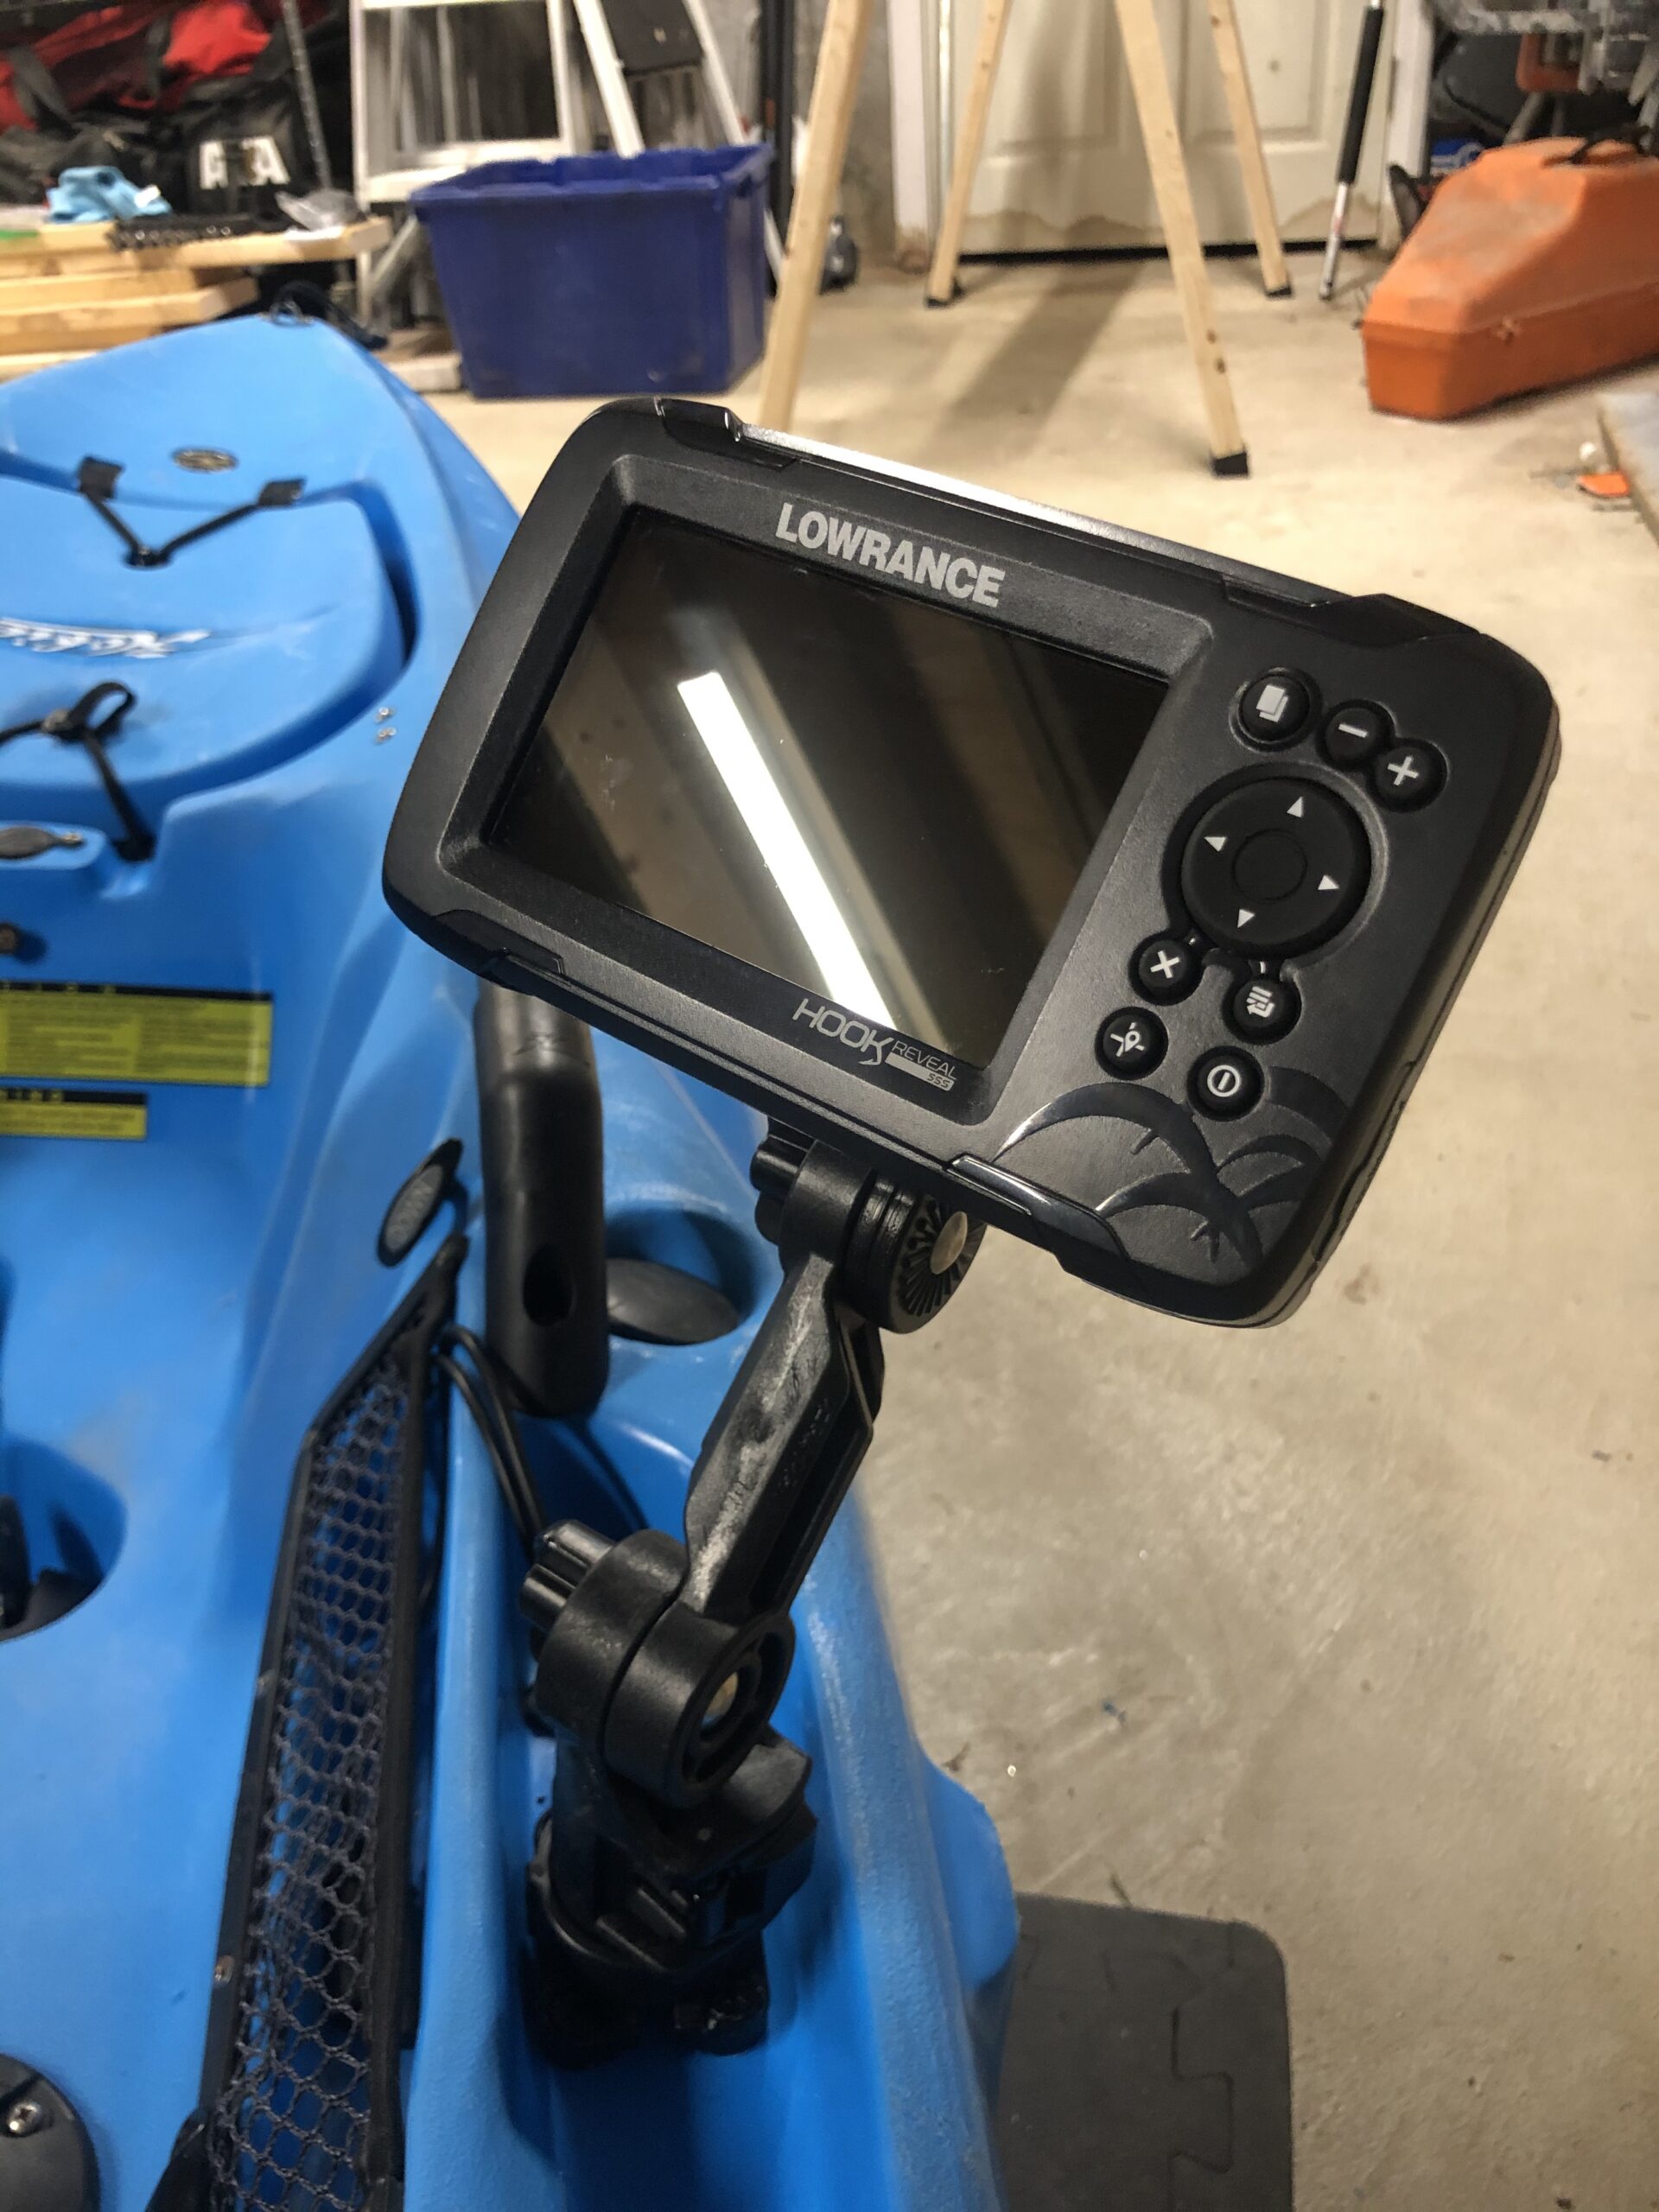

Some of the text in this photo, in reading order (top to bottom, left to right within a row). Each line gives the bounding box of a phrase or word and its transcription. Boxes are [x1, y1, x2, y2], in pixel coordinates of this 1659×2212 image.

[776, 502, 1006, 607] LOWRANCE
[792, 998, 957, 1080] HOOK REVEAL
